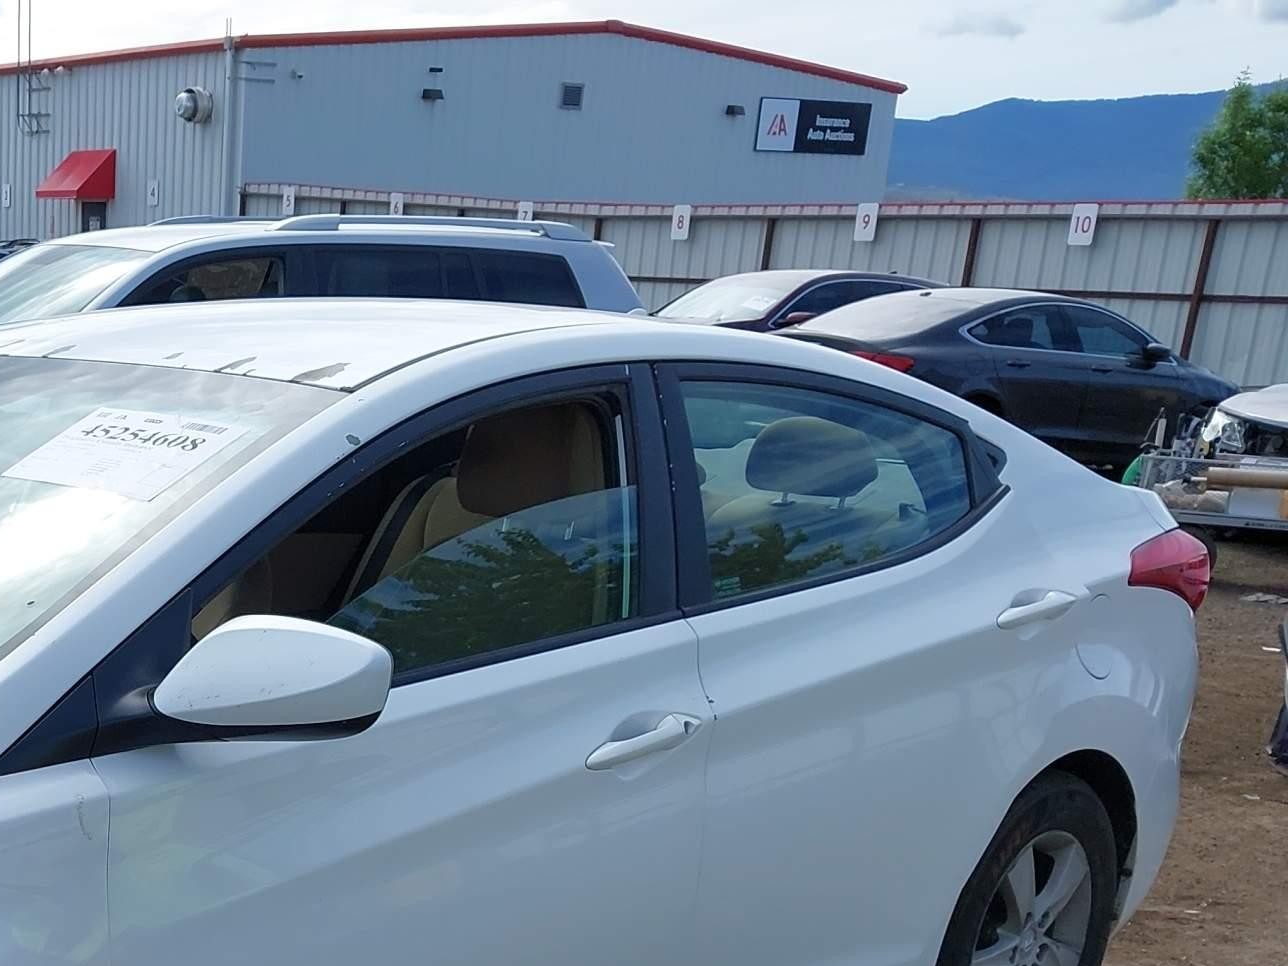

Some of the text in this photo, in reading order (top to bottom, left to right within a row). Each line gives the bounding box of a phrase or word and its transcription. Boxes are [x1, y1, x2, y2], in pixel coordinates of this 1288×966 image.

[393, 200, 400, 215] 6
[677, 214, 685, 230] 8
[862, 213, 871, 230] 9
[1074, 215, 1092, 234] 10
[81, 423, 207, 452] 45254608
